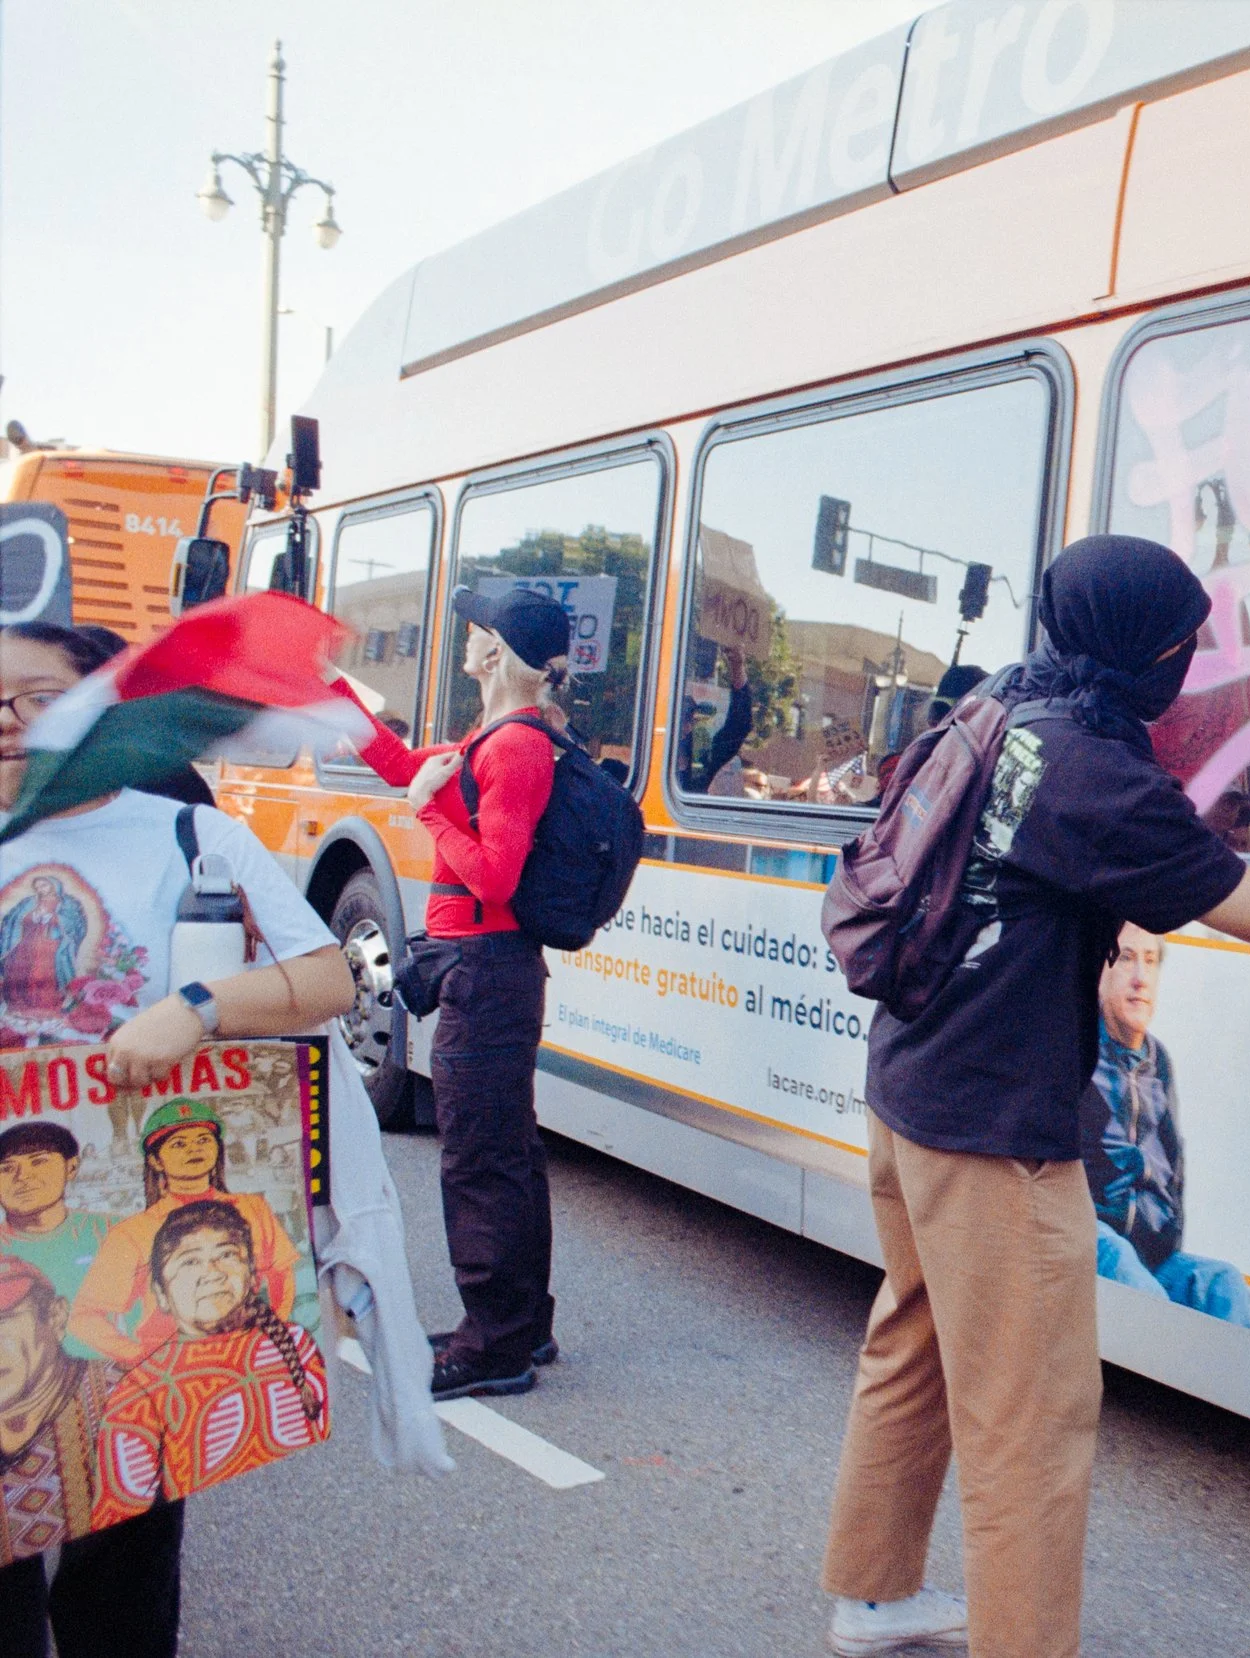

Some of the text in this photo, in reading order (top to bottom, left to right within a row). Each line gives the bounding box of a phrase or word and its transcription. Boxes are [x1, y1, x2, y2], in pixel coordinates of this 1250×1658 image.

[585, 0, 1115, 284] Go Metro
[640, 905, 690, 943] hacia
[697, 918, 715, 947] el
[721, 923, 818, 970] cuidado:
[561, 948, 868, 1041] transporte gratuito al médico.
[568, 1007, 590, 1030] plan
[592, 1013, 631, 1044] integral
[632, 1026, 647, 1048] de
[650, 1031, 701, 1065] Medicare
